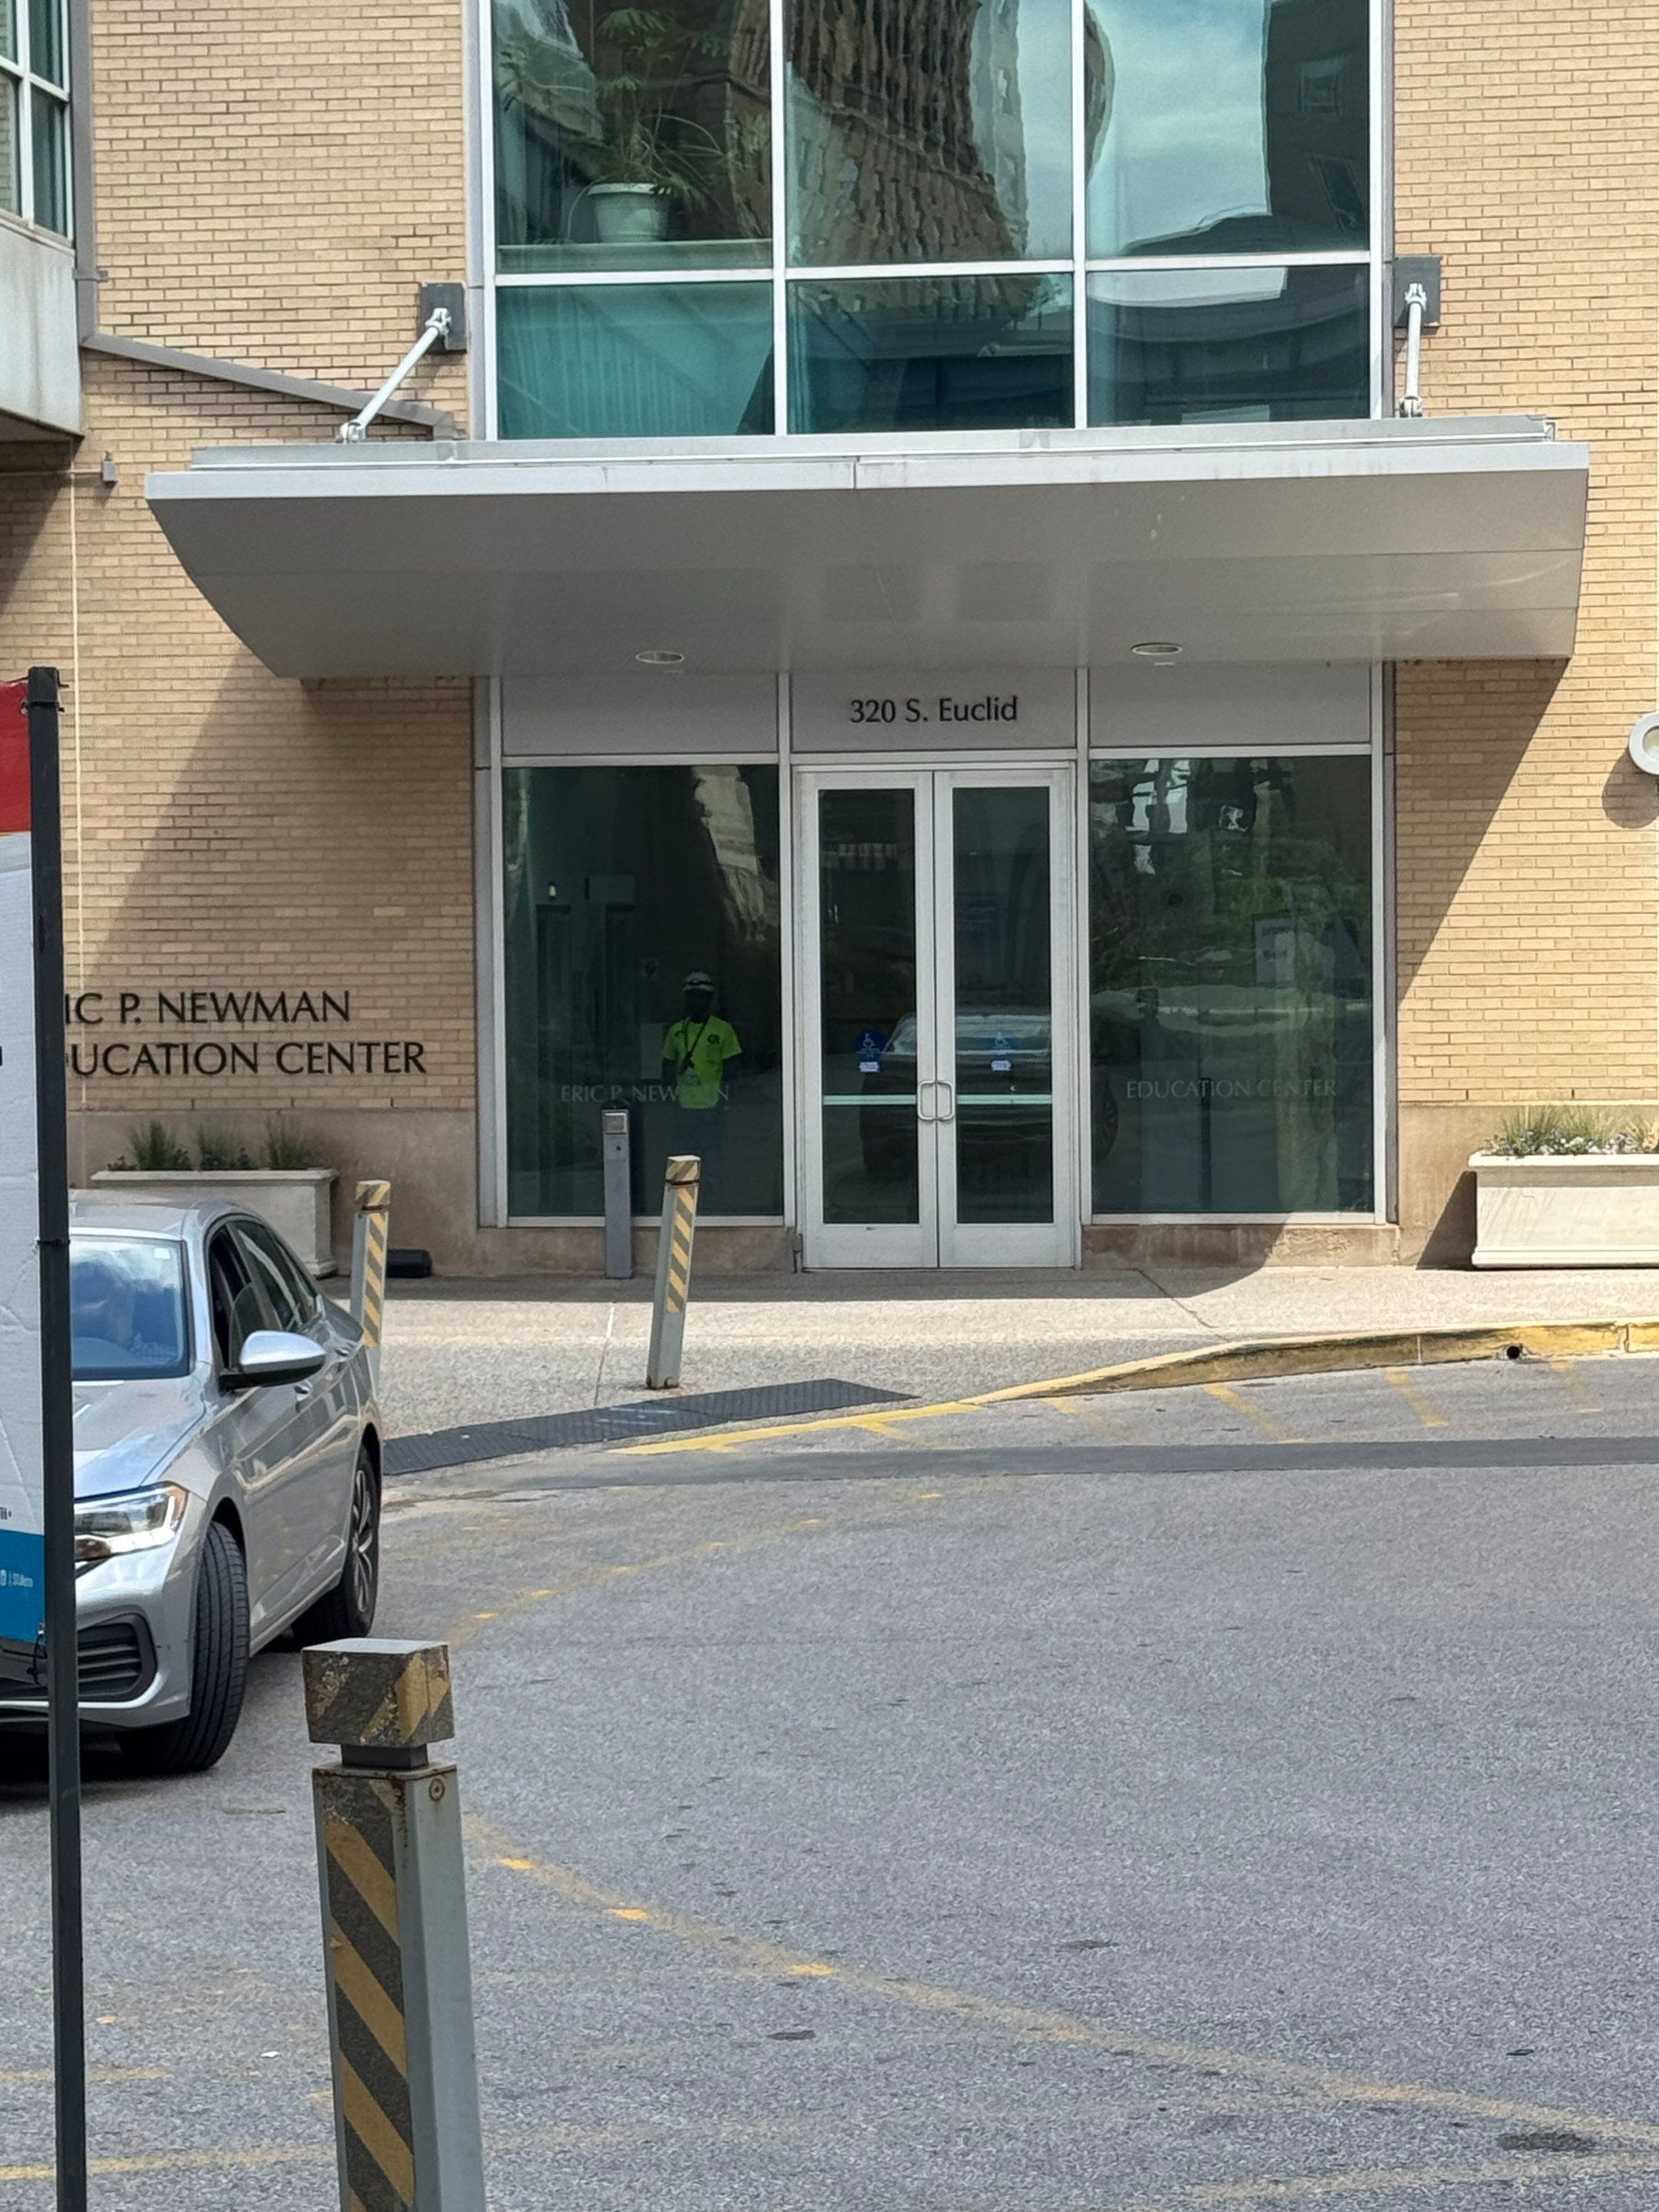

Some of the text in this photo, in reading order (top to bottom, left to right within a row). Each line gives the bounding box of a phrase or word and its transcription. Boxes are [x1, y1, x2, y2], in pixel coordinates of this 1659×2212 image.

[849, 695, 1018, 724] 320 S. Euclid
[65, 990, 350, 1025] IC P. NEWMAN
[66, 1041, 427, 1075] UCATION CENTER
[560, 1084, 604, 1103] ERIC
[631, 1084, 730, 1103] NEWN
[1126, 1078, 1337, 1098] EDUCATION CENTER
